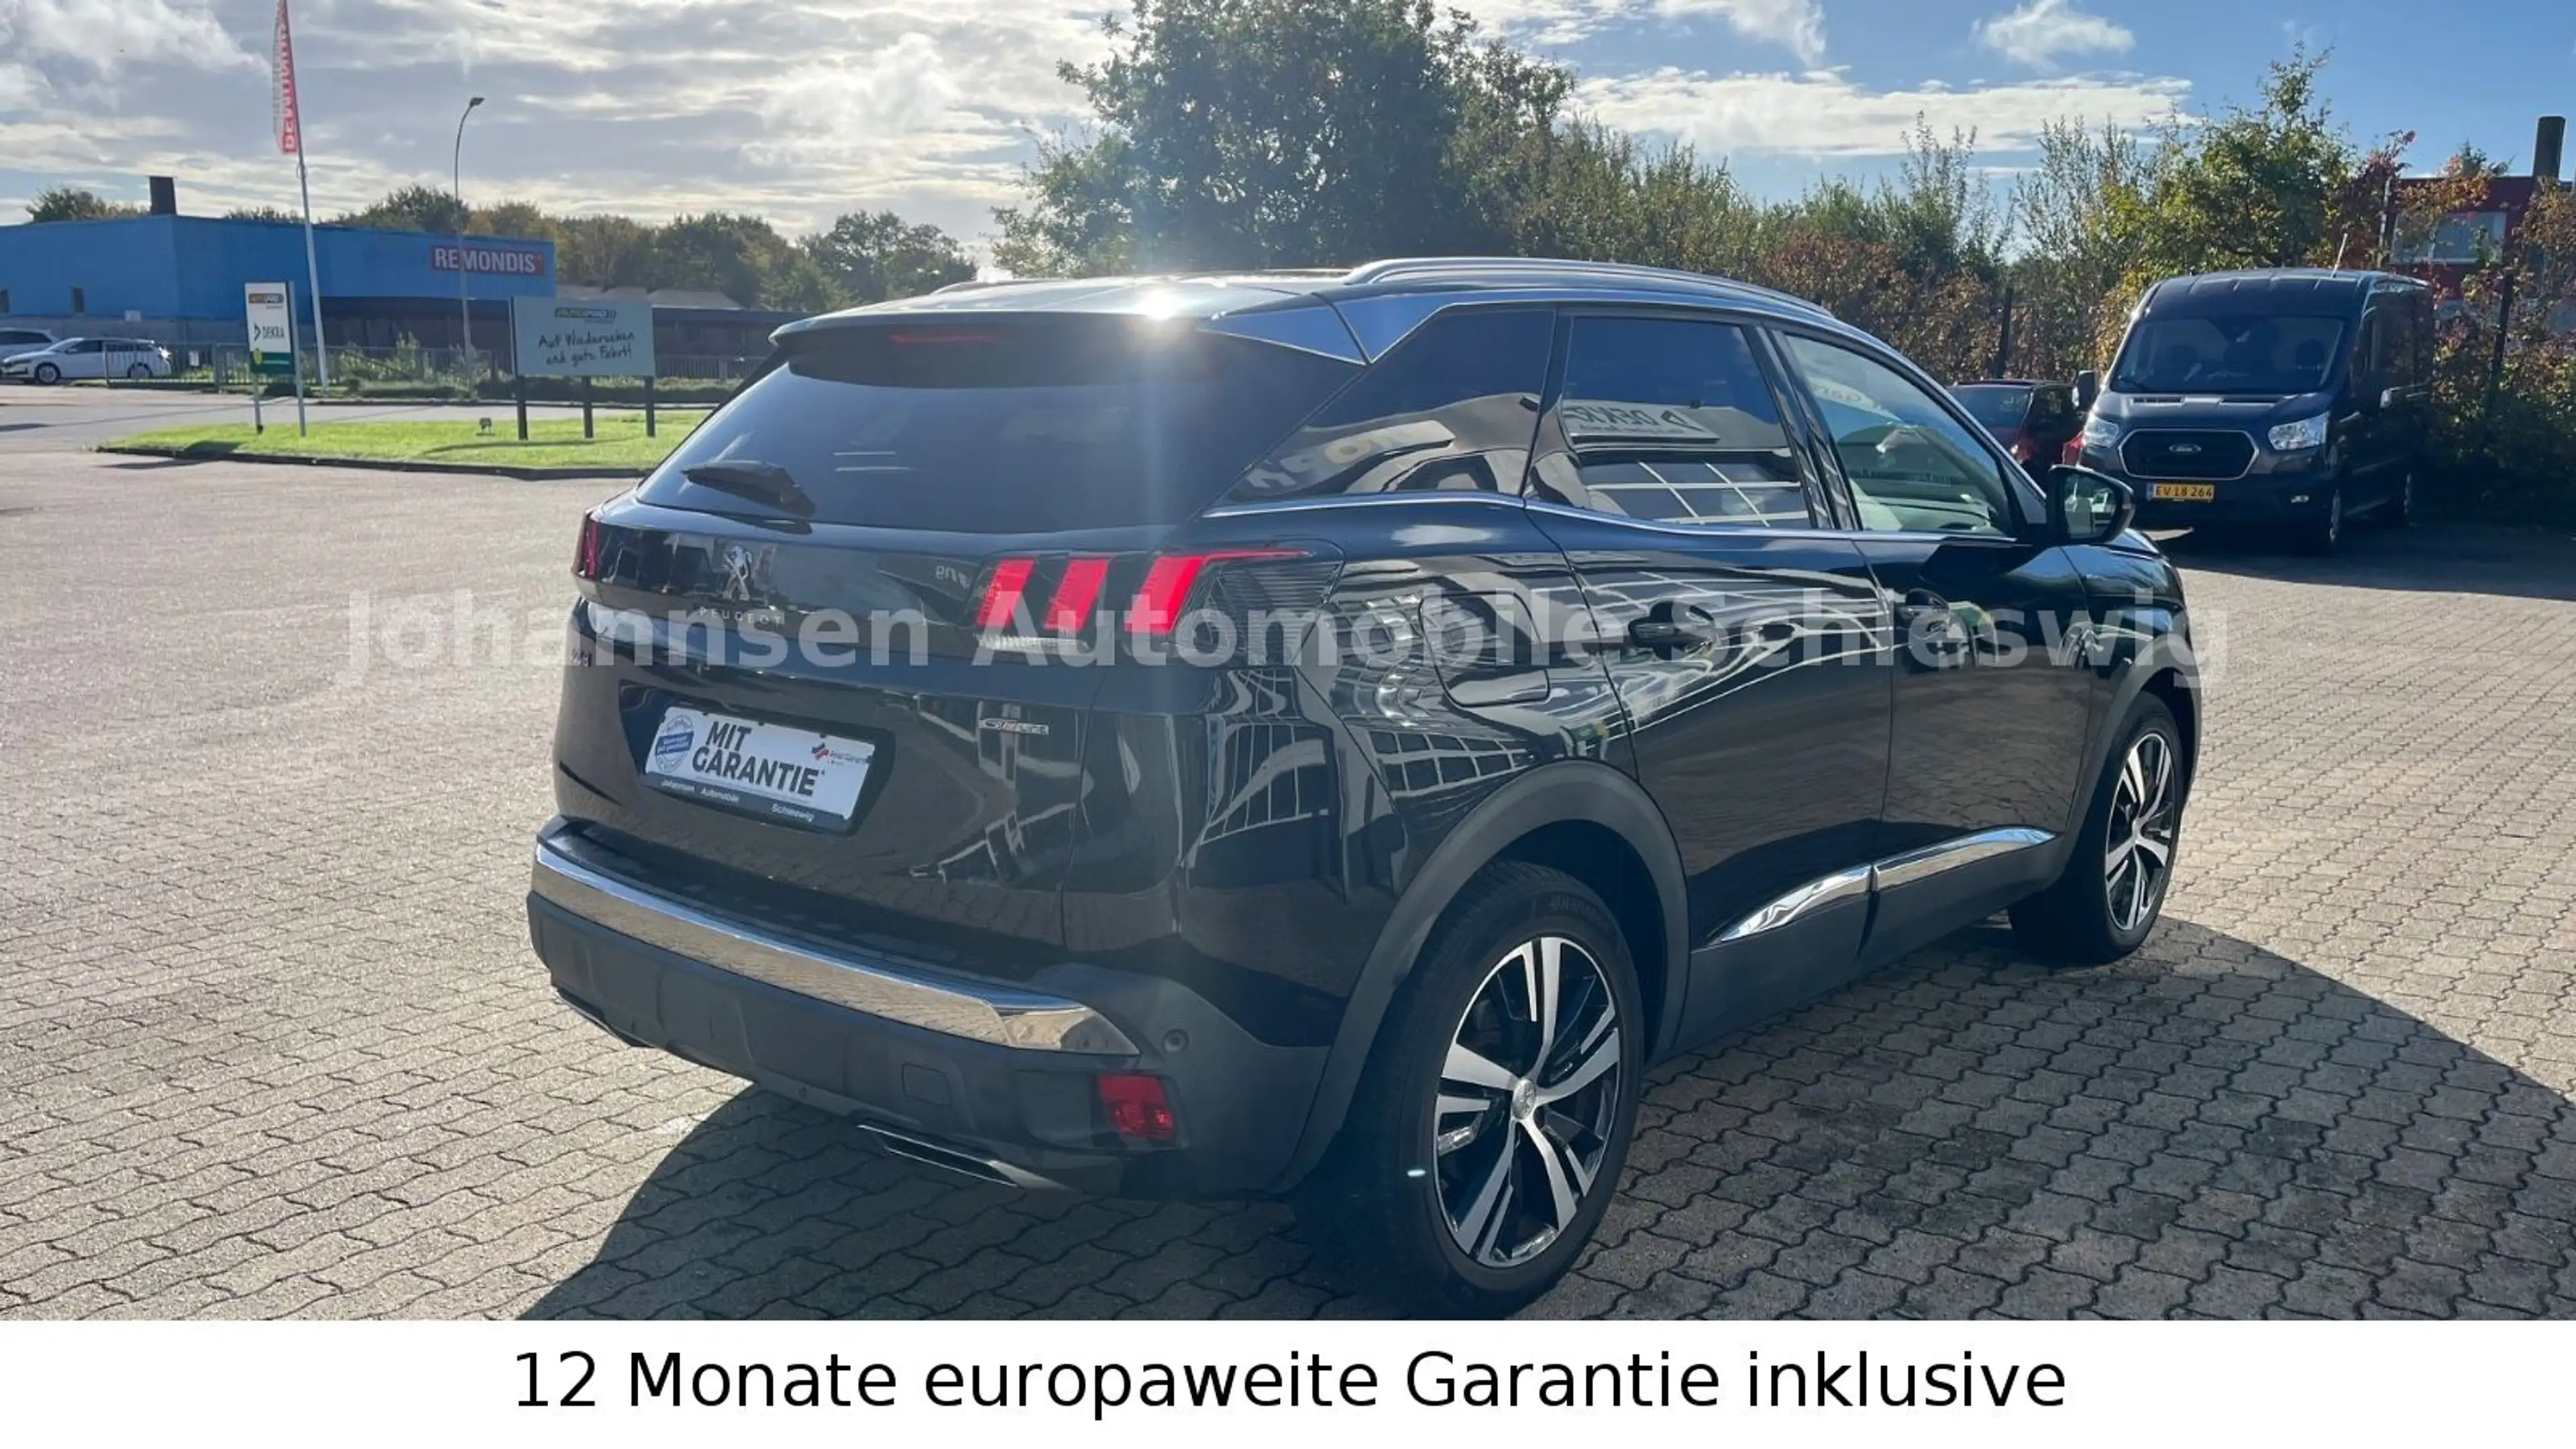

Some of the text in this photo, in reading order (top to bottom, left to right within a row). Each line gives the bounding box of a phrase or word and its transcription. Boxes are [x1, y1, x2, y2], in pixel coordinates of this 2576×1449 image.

[435, 247, 536, 273] REMONDIS
[539, 334, 562, 348] Auf
[546, 352, 567, 364] und
[572, 352, 596, 367] gute
[2156, 486, 2171, 496] EV
[2174, 486, 2187, 496] 18
[699, 606, 786, 626] PEUGEOT
[706, 721, 752, 751] MIT
